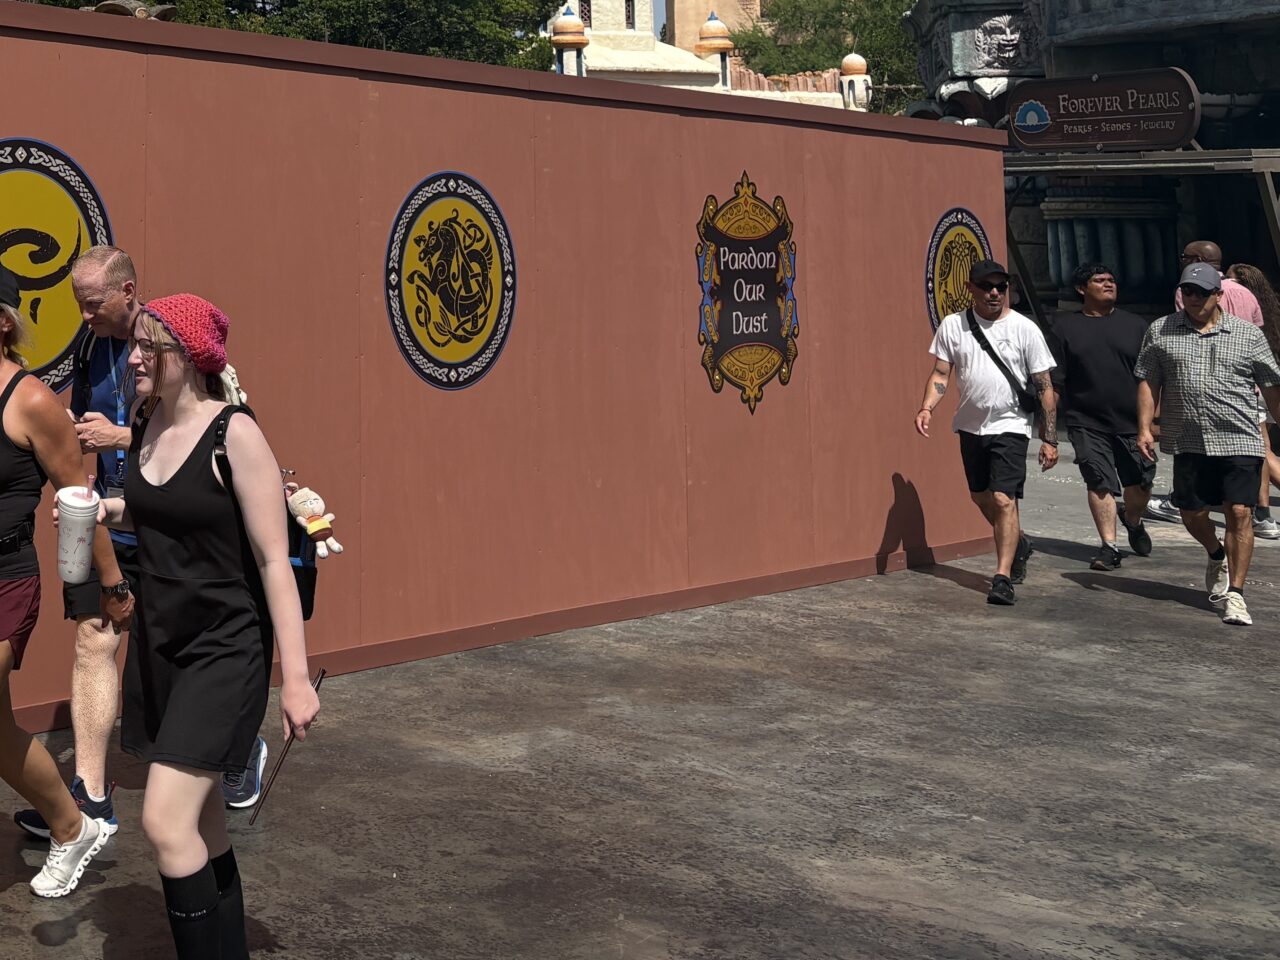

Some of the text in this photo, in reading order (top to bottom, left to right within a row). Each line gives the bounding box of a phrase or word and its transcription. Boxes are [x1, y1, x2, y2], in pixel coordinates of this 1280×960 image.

[720, 246, 776, 270] Pardon
[734, 278, 765, 302] Our
[733, 311, 768, 334] Dust
